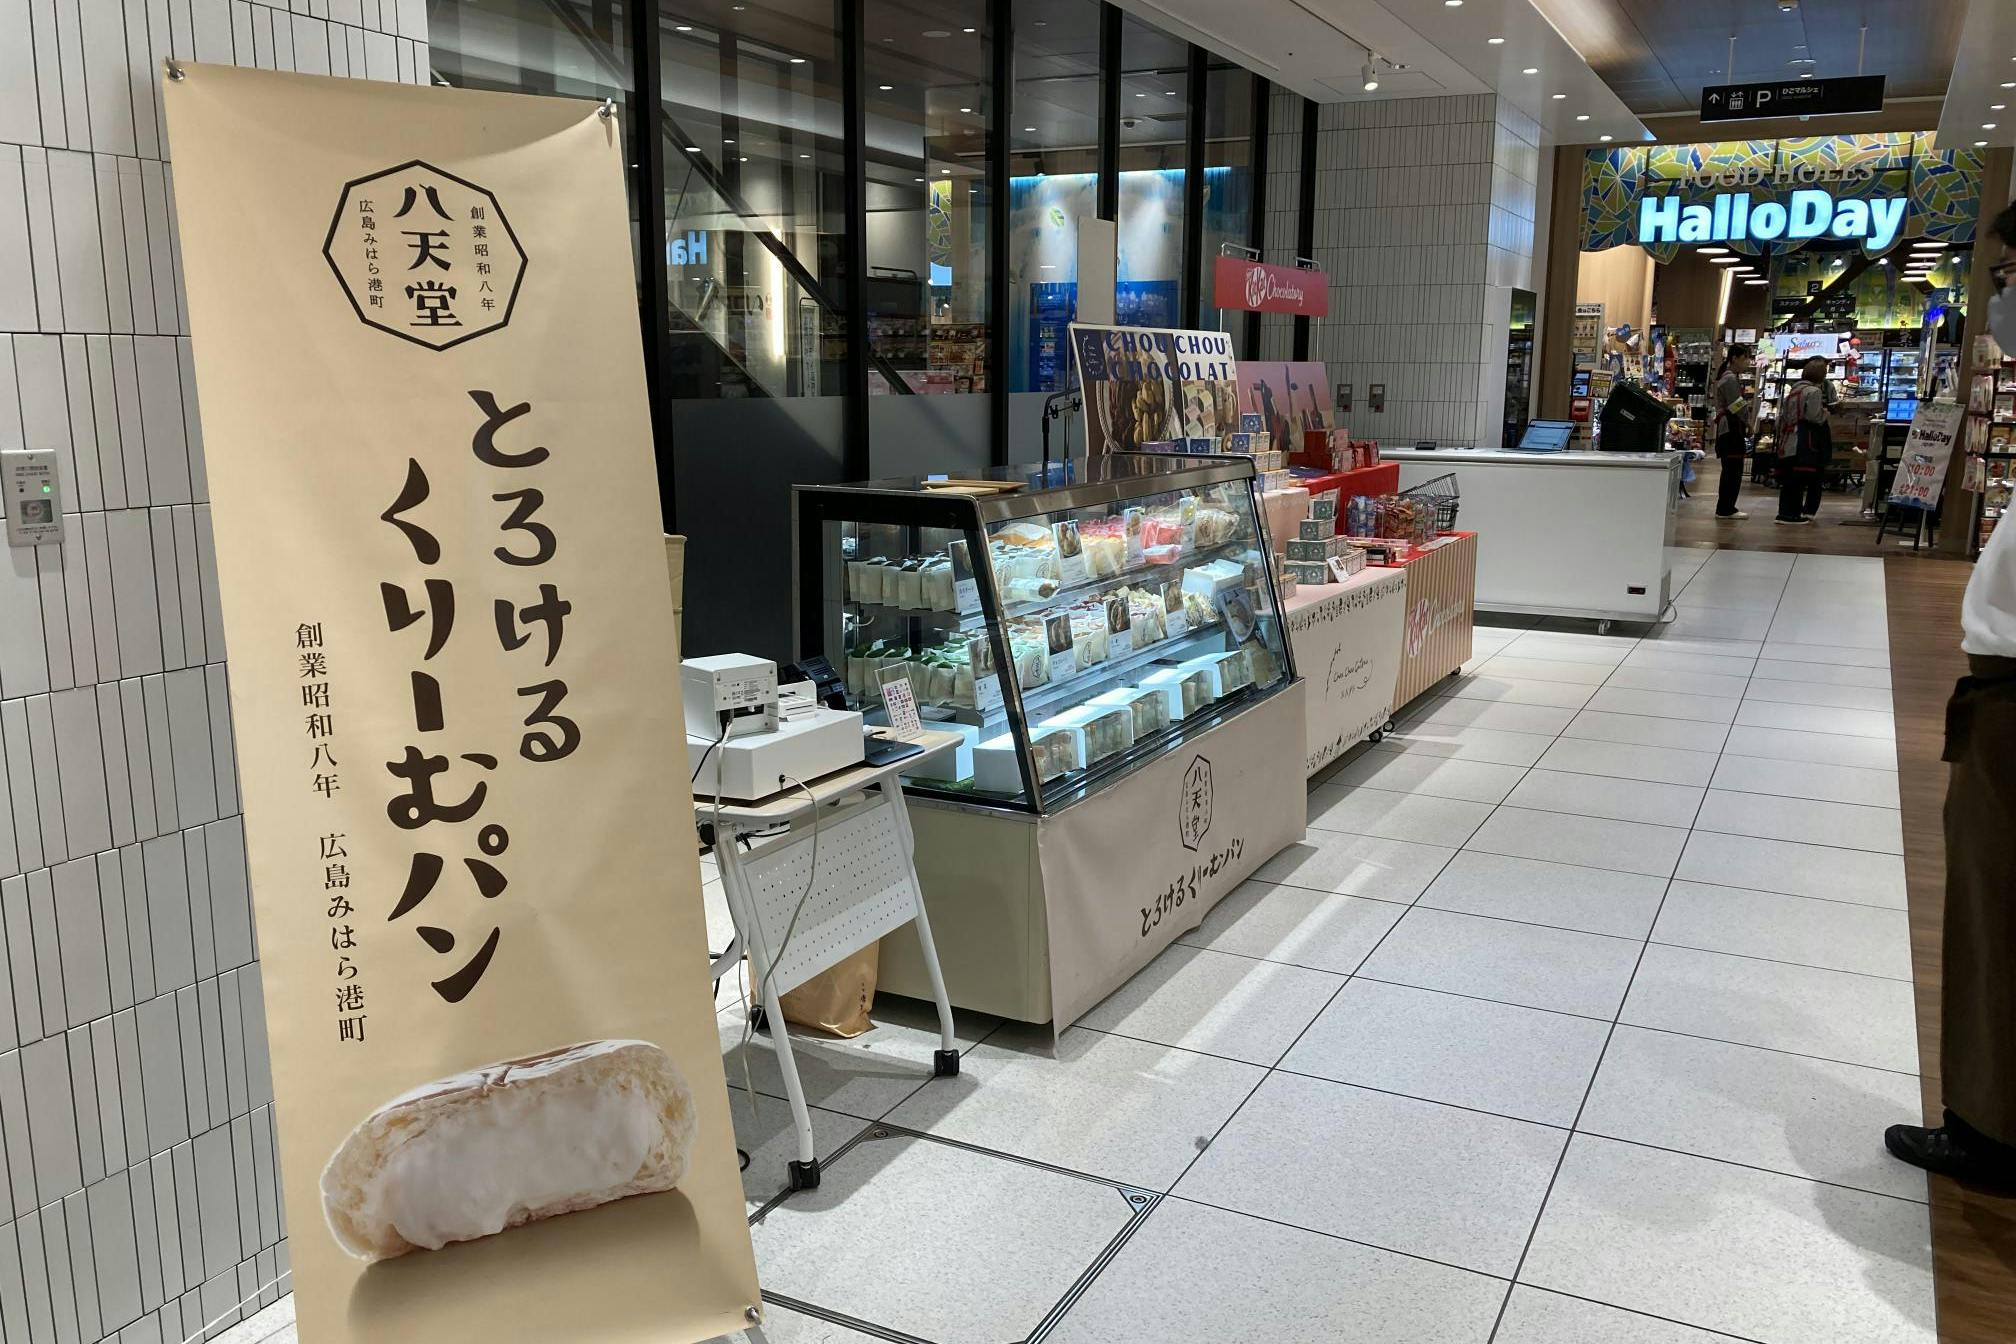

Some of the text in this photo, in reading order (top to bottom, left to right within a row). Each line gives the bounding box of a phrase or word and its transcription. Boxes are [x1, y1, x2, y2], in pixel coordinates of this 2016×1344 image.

[1756, 91, 1772, 108] P
[359, 199, 384, 309] 広島みはら港町
[393, 183, 464, 327] 八天堂
[470, 205, 495, 311] 創業昭和八年
[1639, 190, 1907, 250] HalloDay
[1105, 331, 1227, 354] CHOU CHOU
[467, 390, 581, 762] とろける
[380, 457, 509, 1003] くりーむパン
[295, 622, 367, 1043] 創業昭和八年 広島みはら港町
[1191, 766, 1203, 843] 八天堂
[1140, 837, 1245, 938] とろけるくりーむパン
